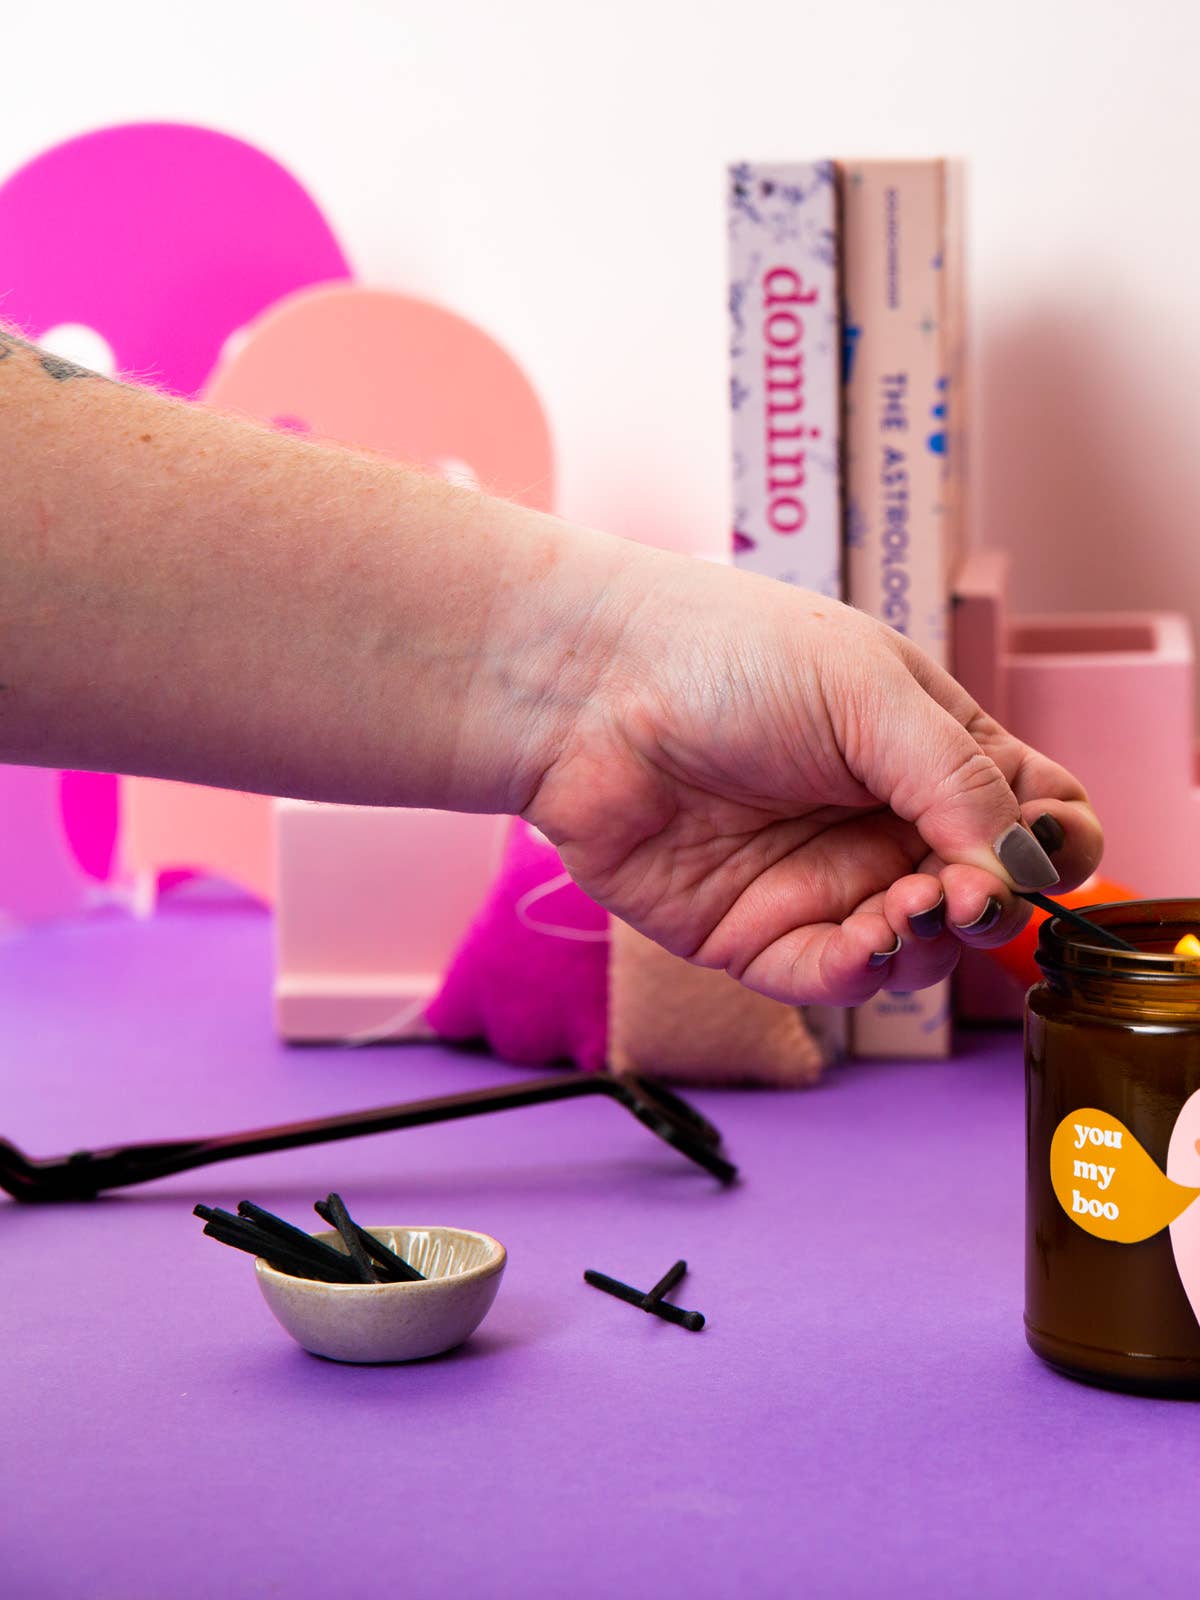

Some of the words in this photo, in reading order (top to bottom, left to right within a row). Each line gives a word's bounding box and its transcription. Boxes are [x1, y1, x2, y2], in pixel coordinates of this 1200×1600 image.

[764, 266, 821, 535] domino
[882, 374, 908, 431] THE
[1074, 1124, 1123, 1149] you
[1073, 1159, 1115, 1190] my
[1072, 1190, 1119, 1221] boo
